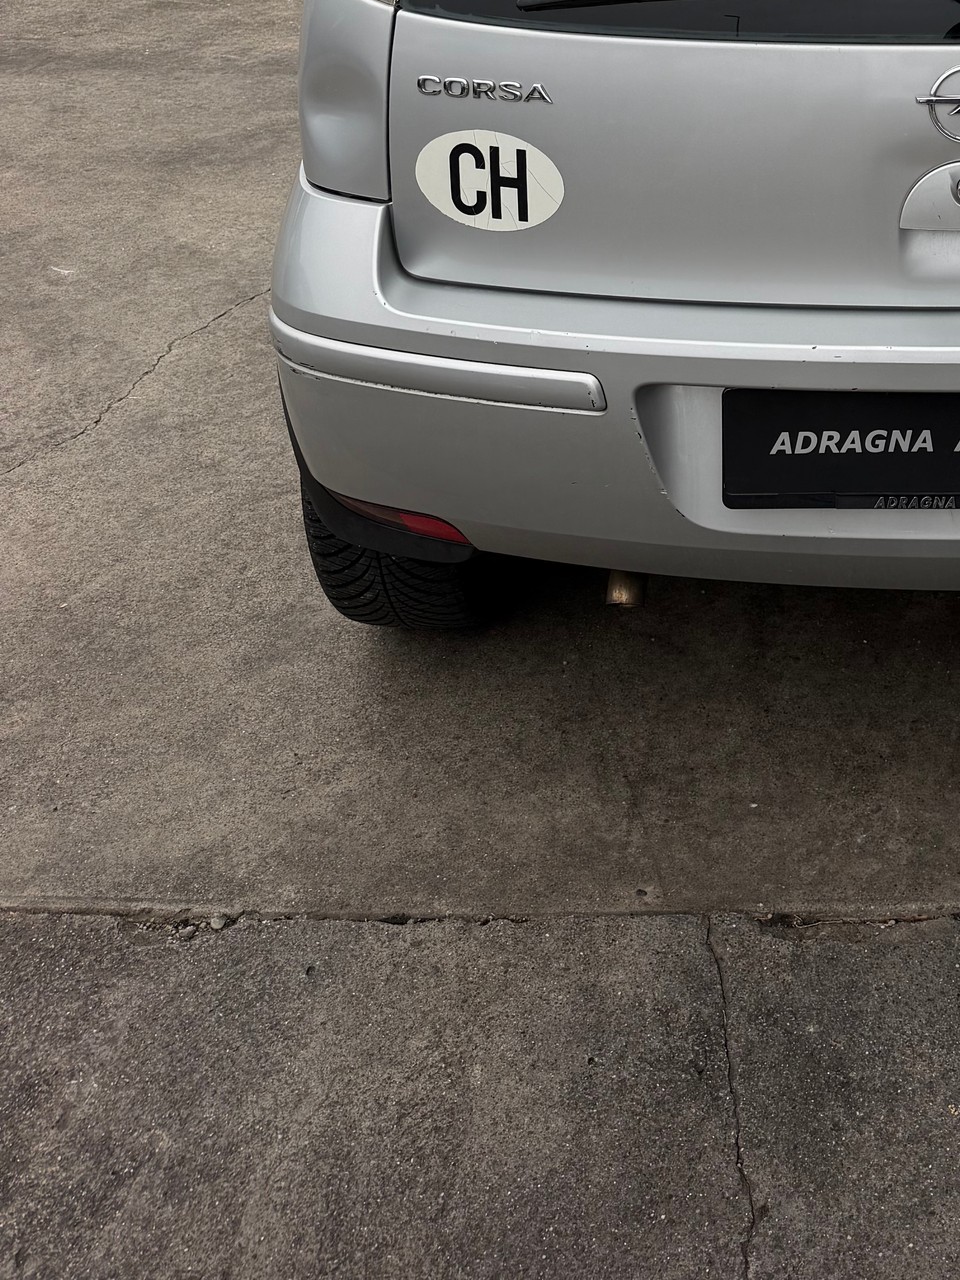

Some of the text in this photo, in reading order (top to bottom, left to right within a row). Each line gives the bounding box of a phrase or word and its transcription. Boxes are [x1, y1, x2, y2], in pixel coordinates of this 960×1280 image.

[417, 75, 553, 104] CORSA
[449, 142, 529, 222] CH
[769, 430, 934, 455] ADRAGNA
[874, 496, 956, 509] ADRAGNA
